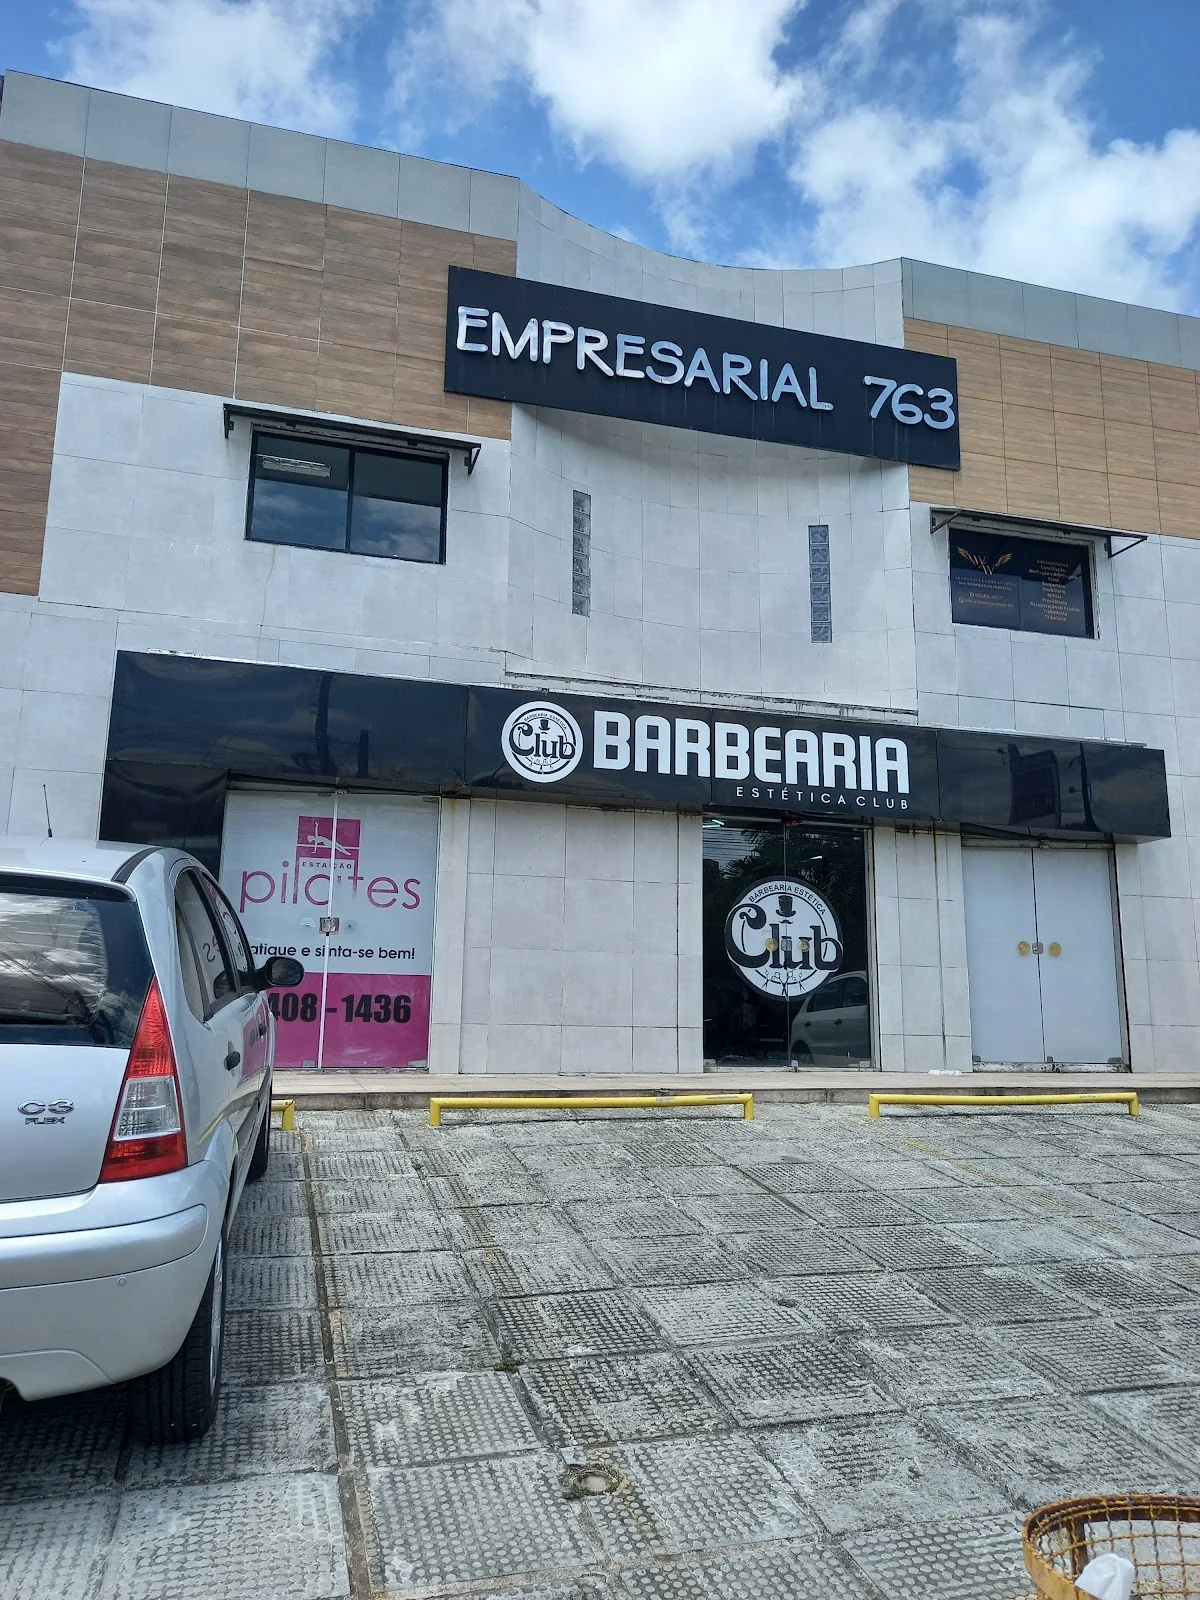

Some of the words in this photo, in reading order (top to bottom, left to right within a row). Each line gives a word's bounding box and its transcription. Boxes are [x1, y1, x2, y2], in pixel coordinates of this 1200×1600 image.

[456, 305, 834, 412] EMPRESARIAL
[863, 374, 957, 431] 763
[509, 722, 576, 760] Club
[593, 709, 911, 795] BARBEARIA
[239, 860, 421, 914] pilates
[748, 884, 793, 903] BARBEARIA
[794, 886, 826, 916] ESTÉTICA
[250, 943, 297, 957] atique
[301, 946, 311, 957] e
[315, 945, 375, 959] sinta-se
[378, 947, 416, 960] bem!
[724, 903, 844, 971] Club
[267, 992, 412, 1024] 408-1436
[17, 1098, 75, 1115] C3
[24, 1116, 66, 1126] FLEX
